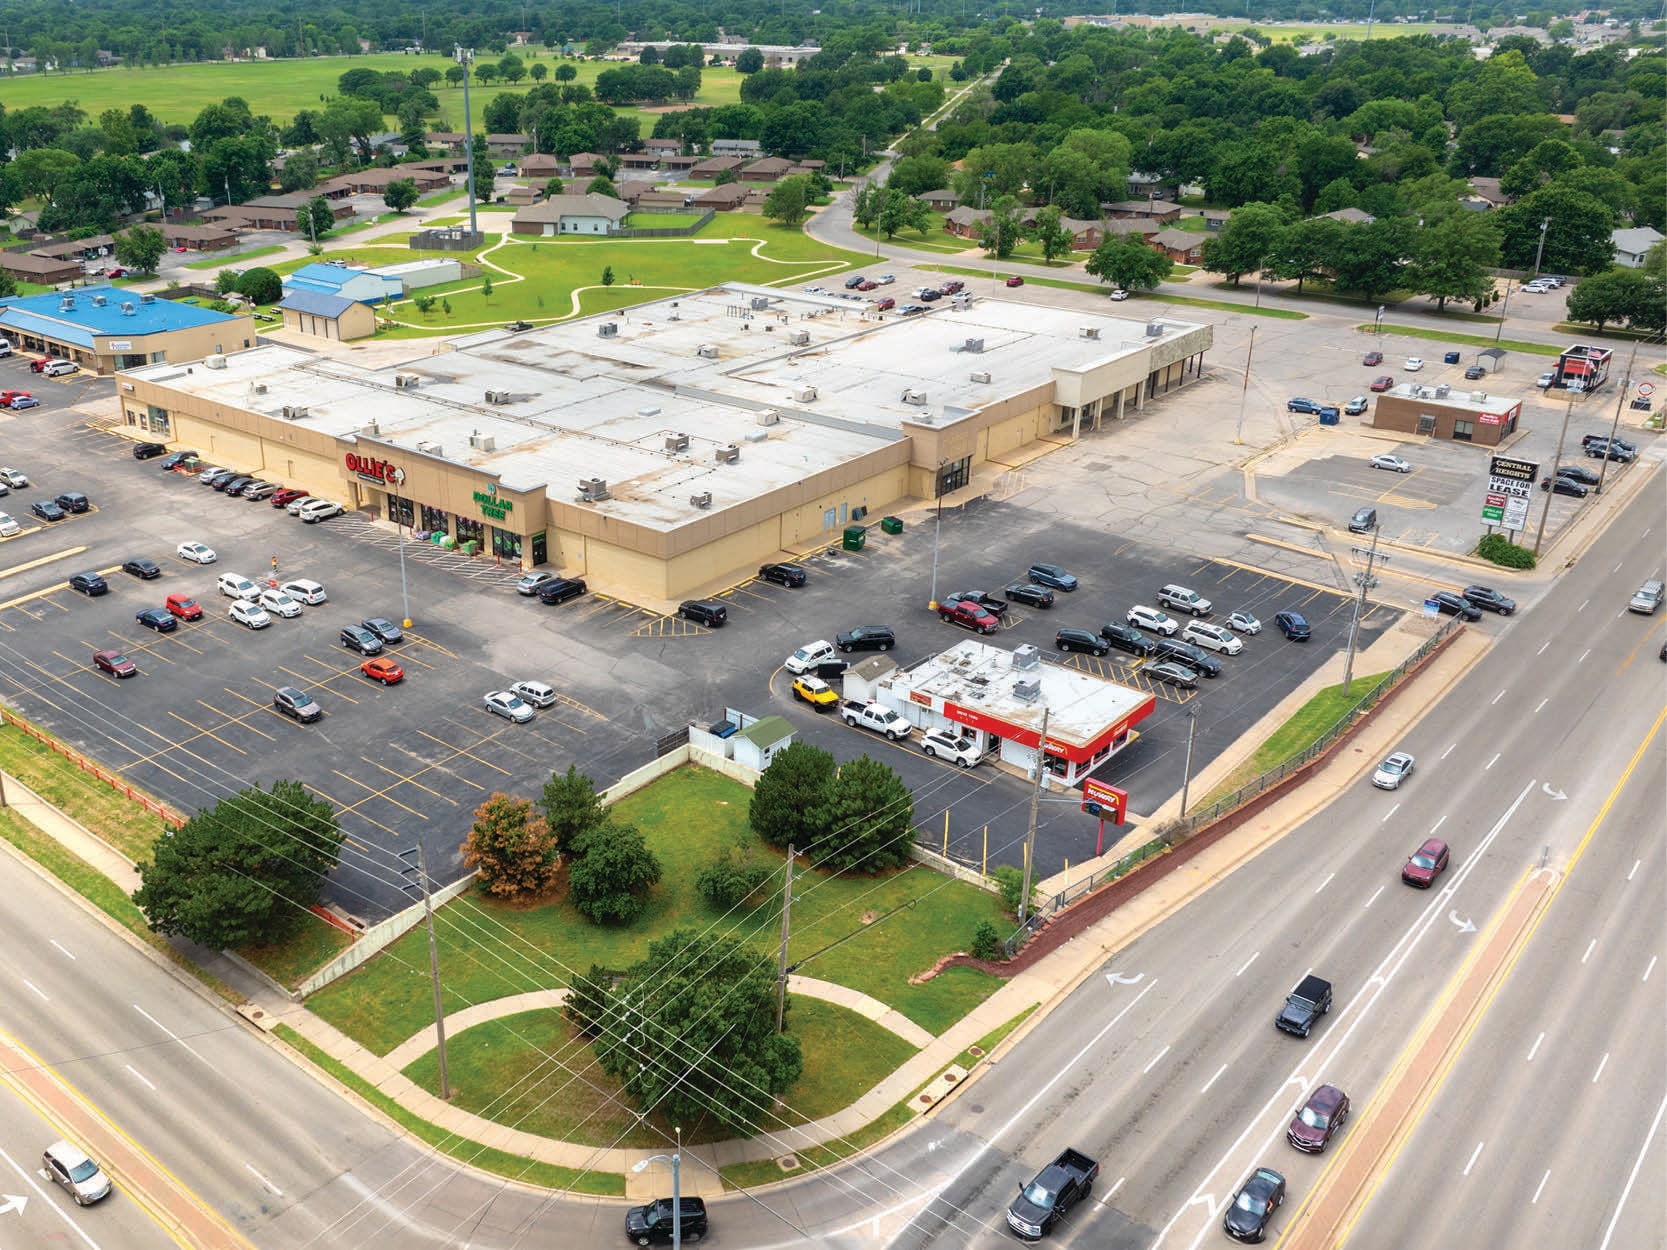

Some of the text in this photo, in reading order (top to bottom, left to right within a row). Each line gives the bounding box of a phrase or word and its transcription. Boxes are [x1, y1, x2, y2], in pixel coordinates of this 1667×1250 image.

[1496, 461, 1532, 471] CENTRAL
[1495, 468, 1531, 479] HEIGHTS
[1491, 476, 1530, 489] SPACE FOR
[1490, 484, 1529, 498] LEASE
[473, 491, 512, 511] DOLLAR
[481, 505, 506, 521] TREE
[1087, 788, 1116, 803] NUWAY
